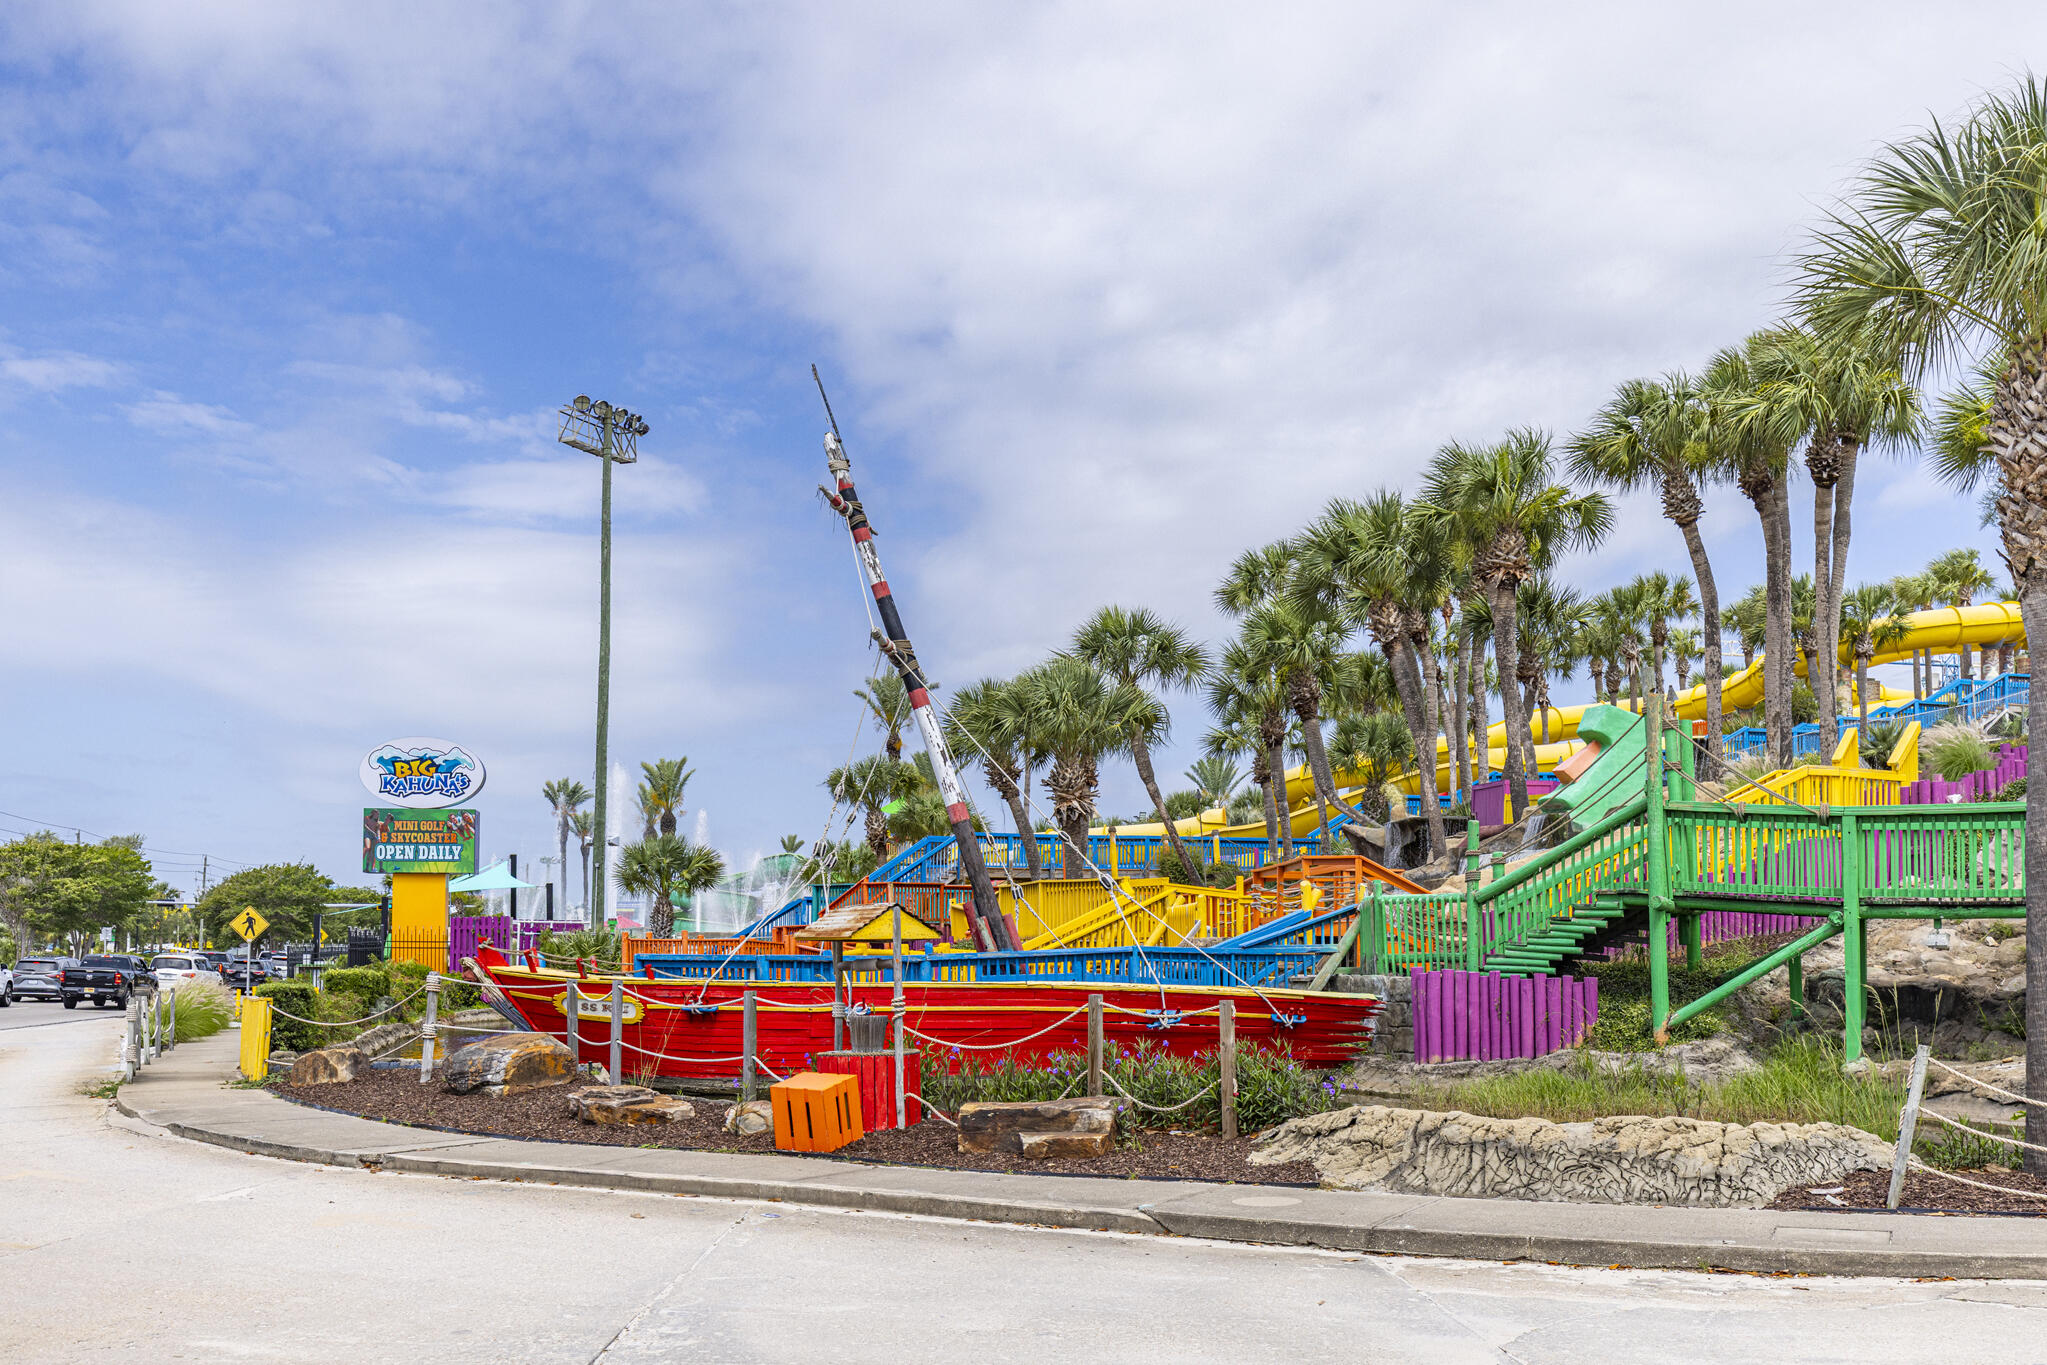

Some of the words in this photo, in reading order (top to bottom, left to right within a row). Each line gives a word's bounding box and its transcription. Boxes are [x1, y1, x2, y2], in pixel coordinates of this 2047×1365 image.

[394, 759, 436, 778] BIG
[394, 820, 418, 831] MINI
[420, 820, 445, 831] GOLF
[381, 833, 388, 843] &
[391, 833, 457, 843] SKYCOASTER
[376, 845, 414, 860] OPEN
[419, 845, 461, 860] DAILY
[581, 1002, 597, 1012] SS
